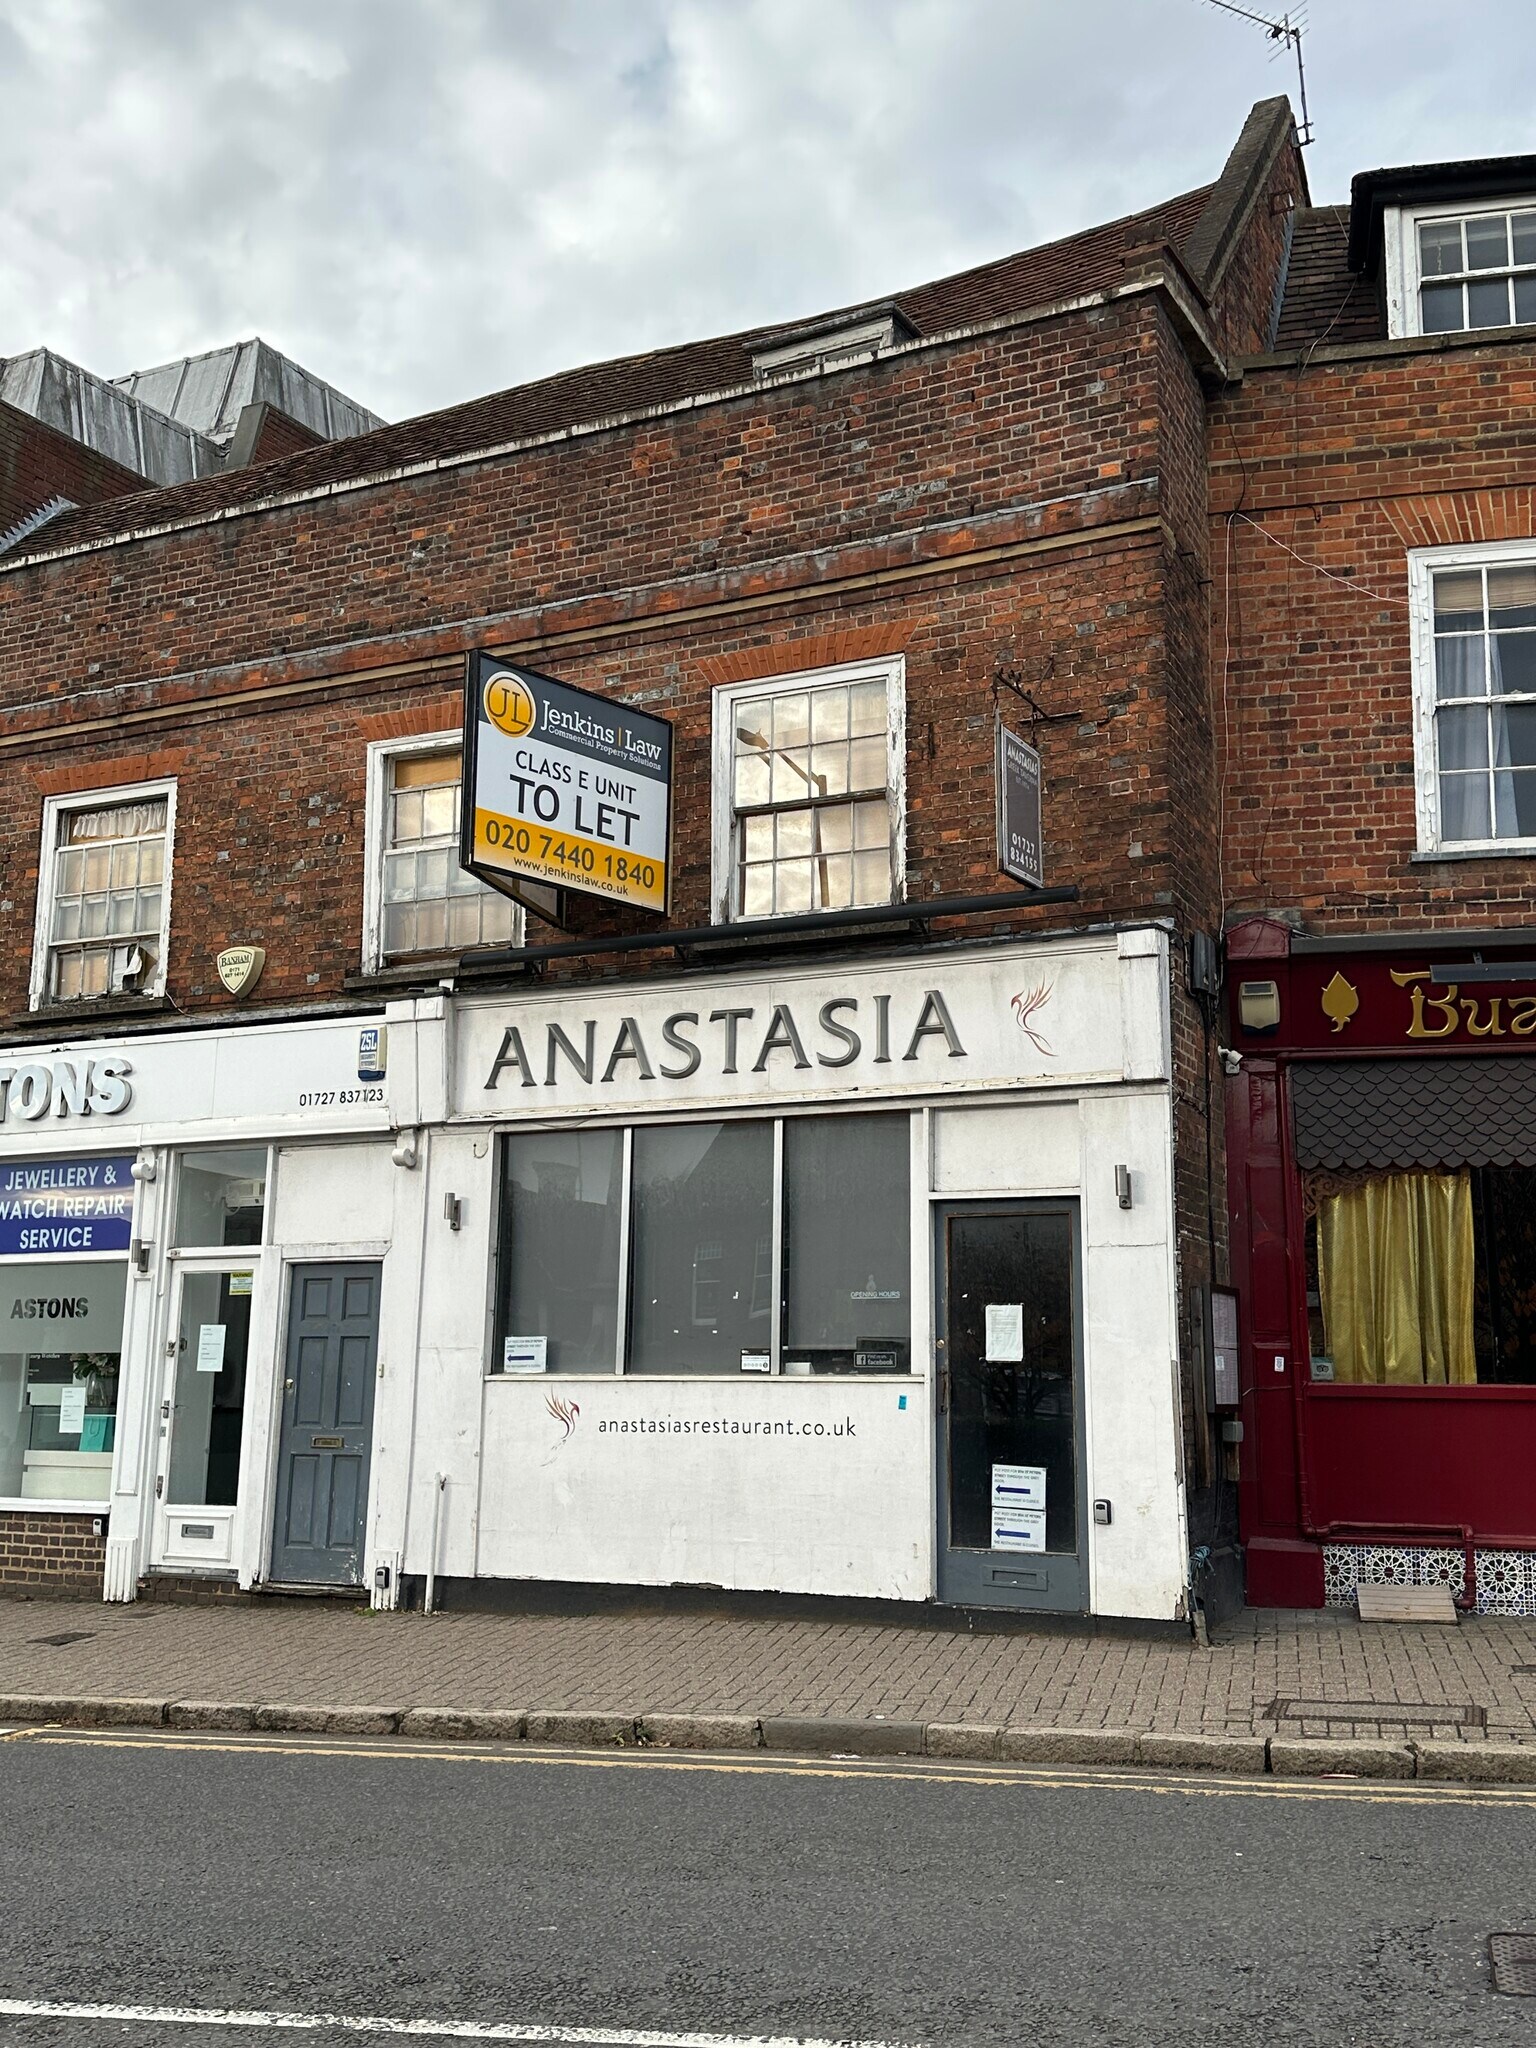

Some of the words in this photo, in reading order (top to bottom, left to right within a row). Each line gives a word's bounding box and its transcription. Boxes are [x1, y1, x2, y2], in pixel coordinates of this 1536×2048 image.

[541, 700, 614, 745] Jenkins
[625, 729, 661, 760] Law
[548, 725, 594, 747] Commercial
[596, 741, 628, 761] Property
[629, 752, 661, 771] Solutions
[516, 750, 571, 783] CLASS
[579, 771, 588, 790] E
[596, 778, 636, 804] UNIT
[509, 774, 559, 822] TO
[575, 795, 640, 846] LET
[486, 819, 530, 854] 020
[539, 834, 594, 872] 7440
[605, 854, 654, 889] 1840
[1012, 832, 1035, 854] 01727
[1010, 846, 1038, 873] 834155
[514, 856, 629, 896] www.jenkinslaw.co.uk
[221, 955, 250, 967] BANHAM
[483, 990, 968, 1090] ANASTASIA
[299, 1092, 336, 1106] 01727
[339, 1088, 384, 1104] 837123
[5, 1165, 100, 1191] JEWELLERY
[104, 1165, 117, 1185] &
[0, 1199, 57, 1220] WATCH
[63, 1194, 125, 1218] REPAIR
[19, 1226, 93, 1249] SERVICE
[879, 1290, 900, 1298] HOURS
[10, 1297, 89, 1319] ASTONS
[598, 1413, 856, 1437] anastasiasrestaurant.co.uk
